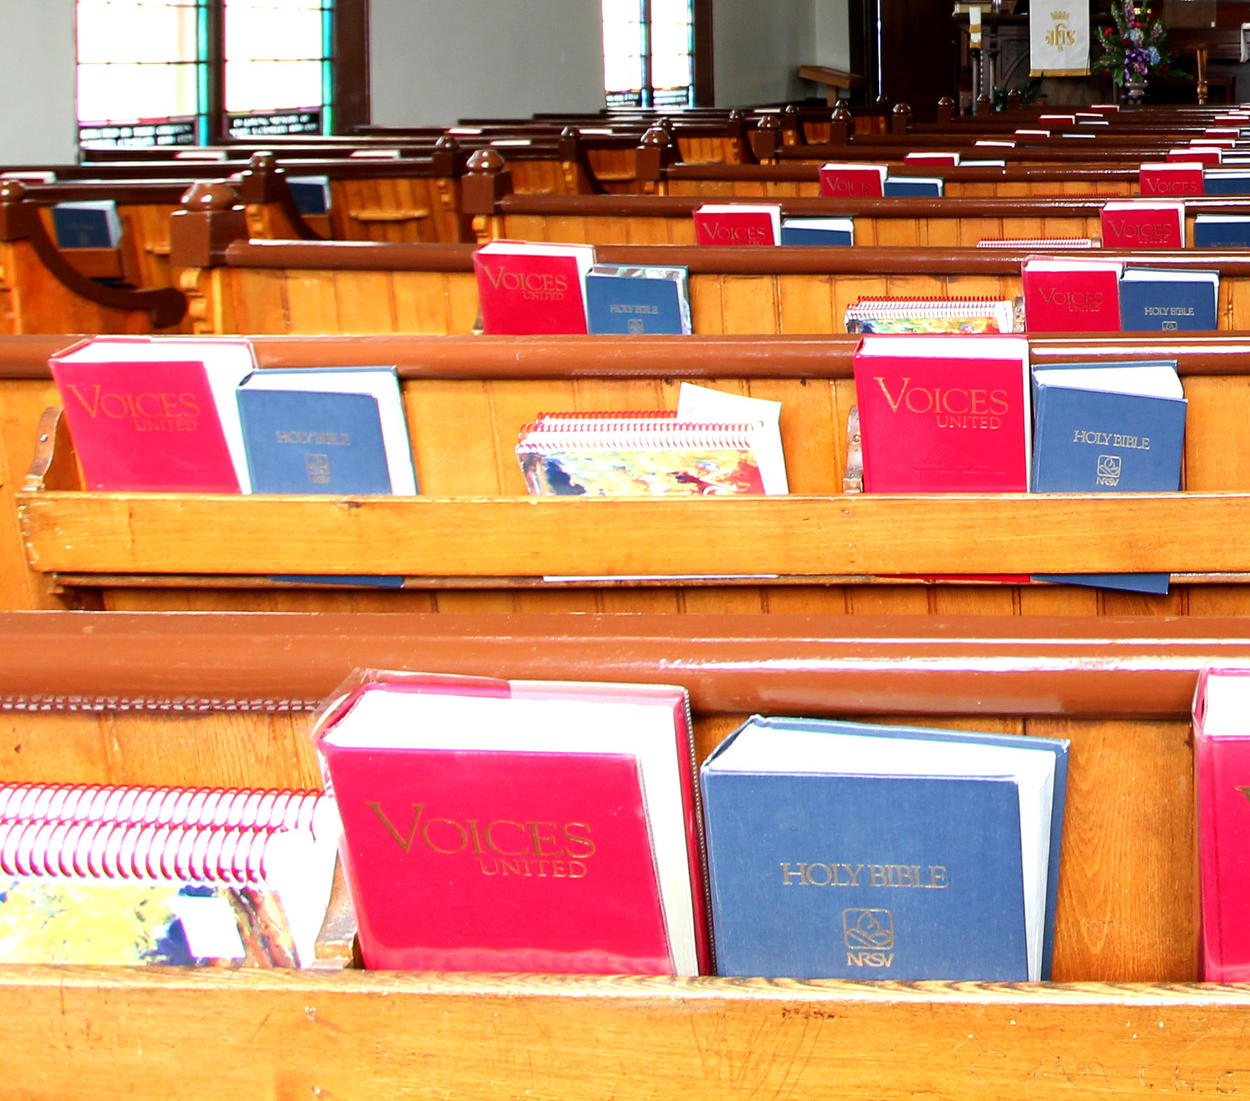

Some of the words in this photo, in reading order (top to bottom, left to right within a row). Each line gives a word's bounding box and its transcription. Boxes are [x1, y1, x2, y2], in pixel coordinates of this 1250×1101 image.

[1146, 178, 1197, 194] VOICES
[702, 221, 766, 240] VOICES
[1108, 220, 1173, 239] VOICES
[481, 265, 568, 292] VOICES
[1038, 287, 1104, 306] VOICES
[1069, 303, 1100, 313] UNITED
[1145, 307, 1169, 317] HOLY
[1170, 307, 1195, 317] BIBLE
[66, 384, 201, 419] VOICES
[873, 376, 1010, 416] VOICES
[135, 419, 197, 432] UNITED
[936, 415, 1002, 430] UNITED
[275, 430, 314, 445] HOLY
[1074, 429, 1113, 446] HOLY
[1113, 434, 1151, 451] BIBLE
[1097, 477, 1120, 487] NRSV
[365, 802, 596, 860] VOICES
[478, 856, 588, 880] UNITED
[780, 862, 865, 888] HOLY
[868, 864, 950, 889] BIBLE
[846, 952, 895, 968] NRSV
